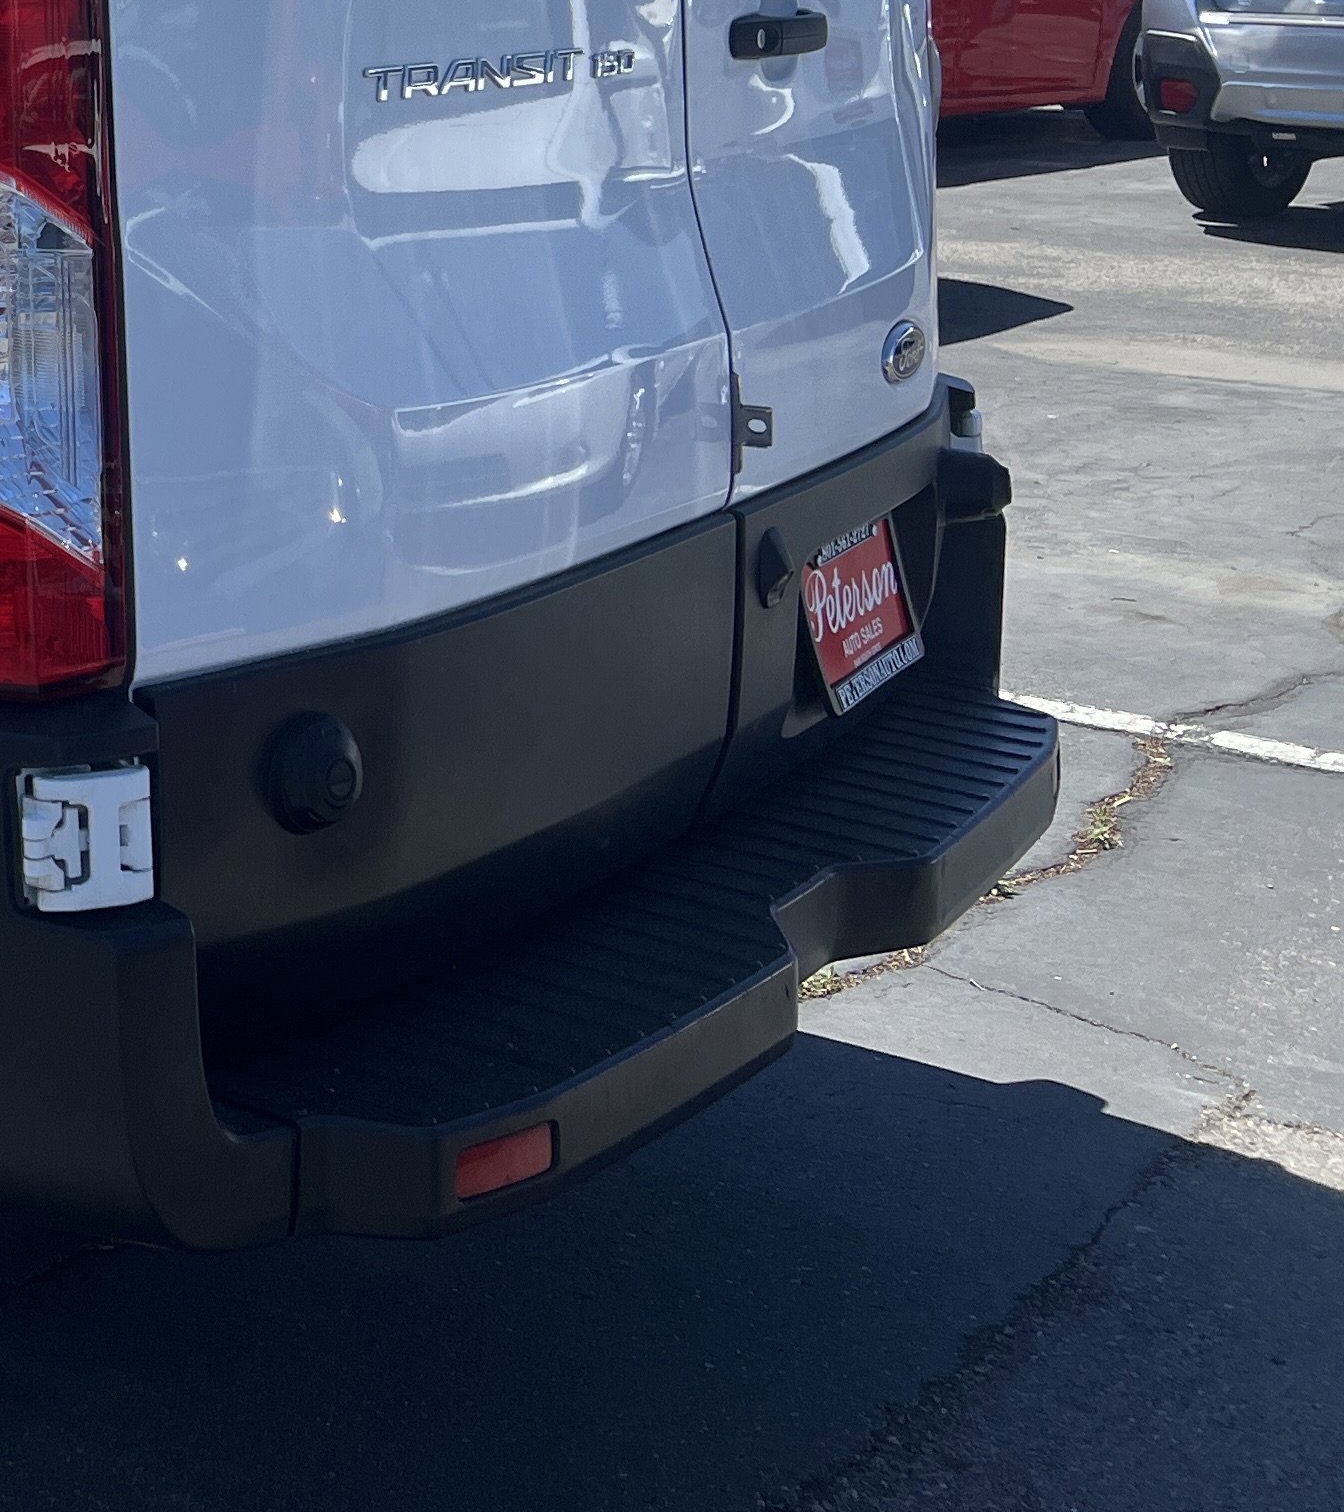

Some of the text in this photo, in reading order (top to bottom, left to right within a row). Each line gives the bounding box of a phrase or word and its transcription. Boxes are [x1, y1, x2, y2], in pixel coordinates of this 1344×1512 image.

[362, 47, 635, 103] TRANSIT 150
[805, 561, 898, 643] Peterson
[842, 631, 862, 658] AUTO
[860, 616, 884, 645] SALES
